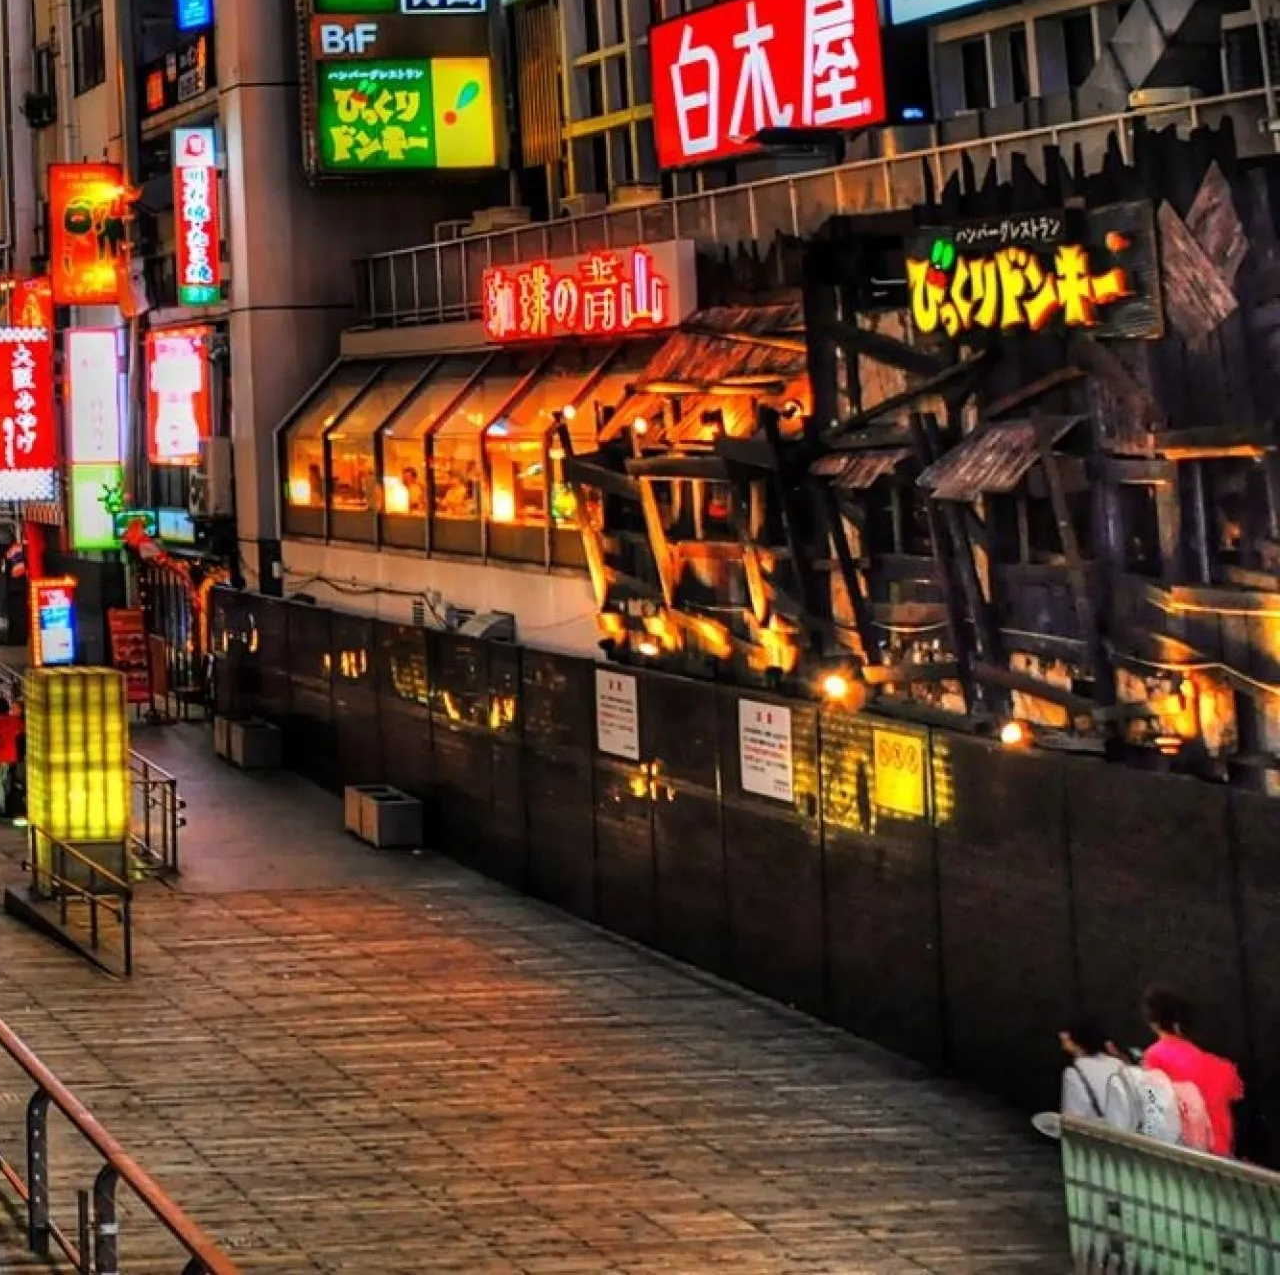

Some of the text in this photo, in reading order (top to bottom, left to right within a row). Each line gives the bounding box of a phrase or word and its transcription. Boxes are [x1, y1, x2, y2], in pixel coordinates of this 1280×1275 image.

[329, 124, 429, 163] ドンキー
[905, 243, 1126, 338] びっくりドンキー
